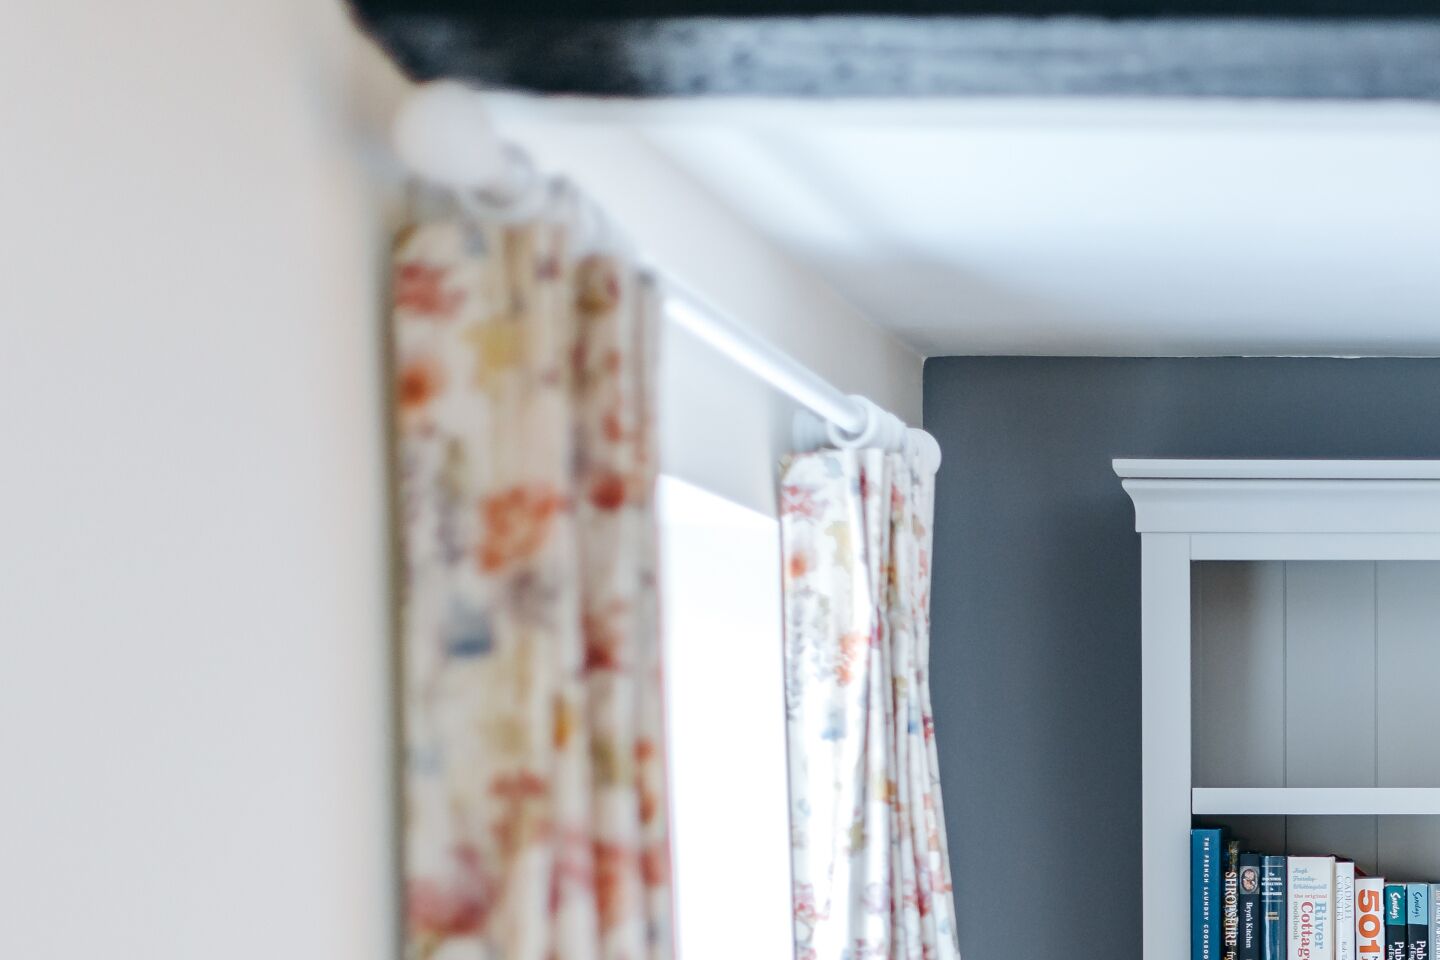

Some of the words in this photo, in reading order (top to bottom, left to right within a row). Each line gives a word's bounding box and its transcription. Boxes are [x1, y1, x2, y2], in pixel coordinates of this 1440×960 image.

[1224, 872, 1237, 946] SHROPSHIRE
[1245, 902, 1254, 922] Bryn's
[1336, 874, 1344, 921] COUNTRY
[1358, 888, 1380, 953] 501
[1246, 923, 1254, 948] Kitchen
[1314, 901, 1326, 949] River
